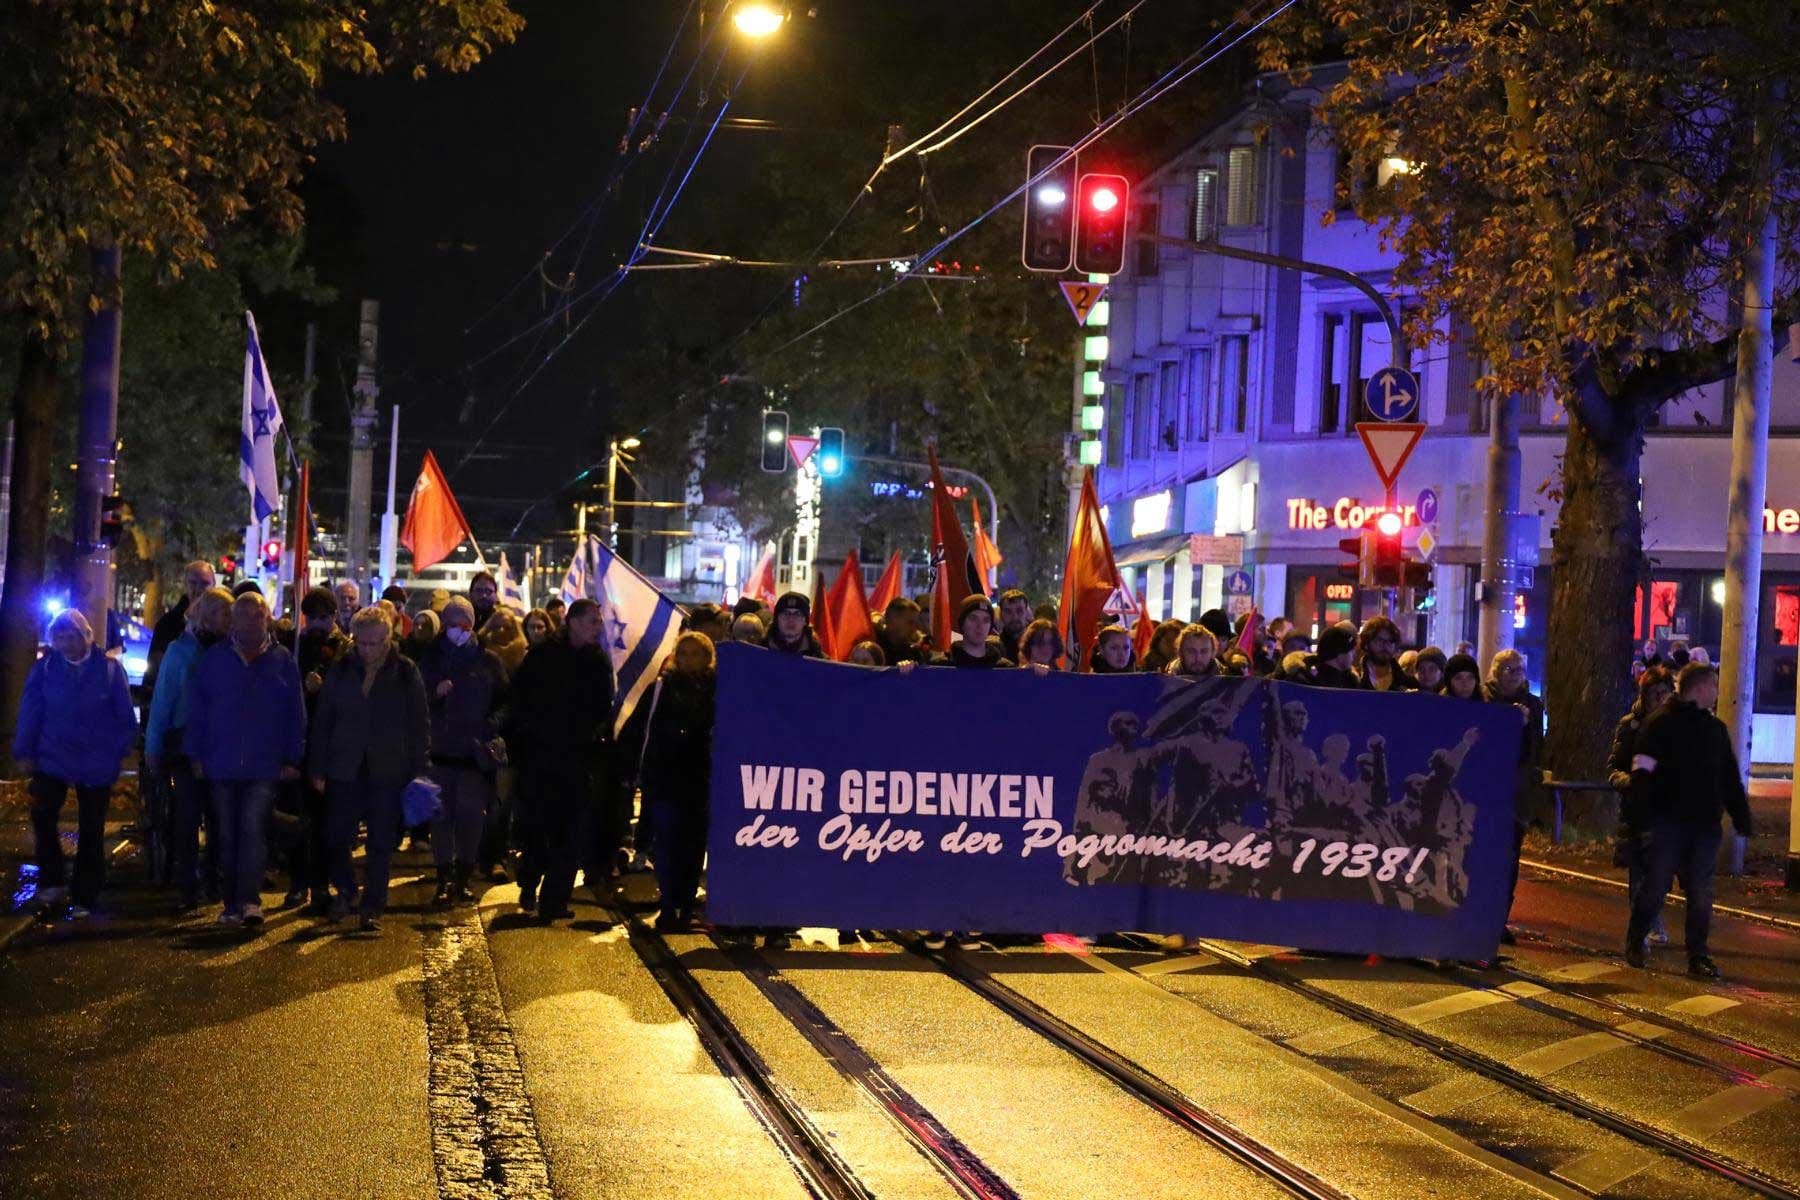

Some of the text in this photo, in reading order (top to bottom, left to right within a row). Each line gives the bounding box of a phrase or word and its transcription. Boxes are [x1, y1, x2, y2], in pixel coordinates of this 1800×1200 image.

[1077, 286, 1089, 309] 2
[1286, 496, 1416, 530] The Corr
[740, 764, 1054, 819] WIR GEDENKEN
[735, 813, 1430, 884] der Opfer der Pogromnacht 1938!
